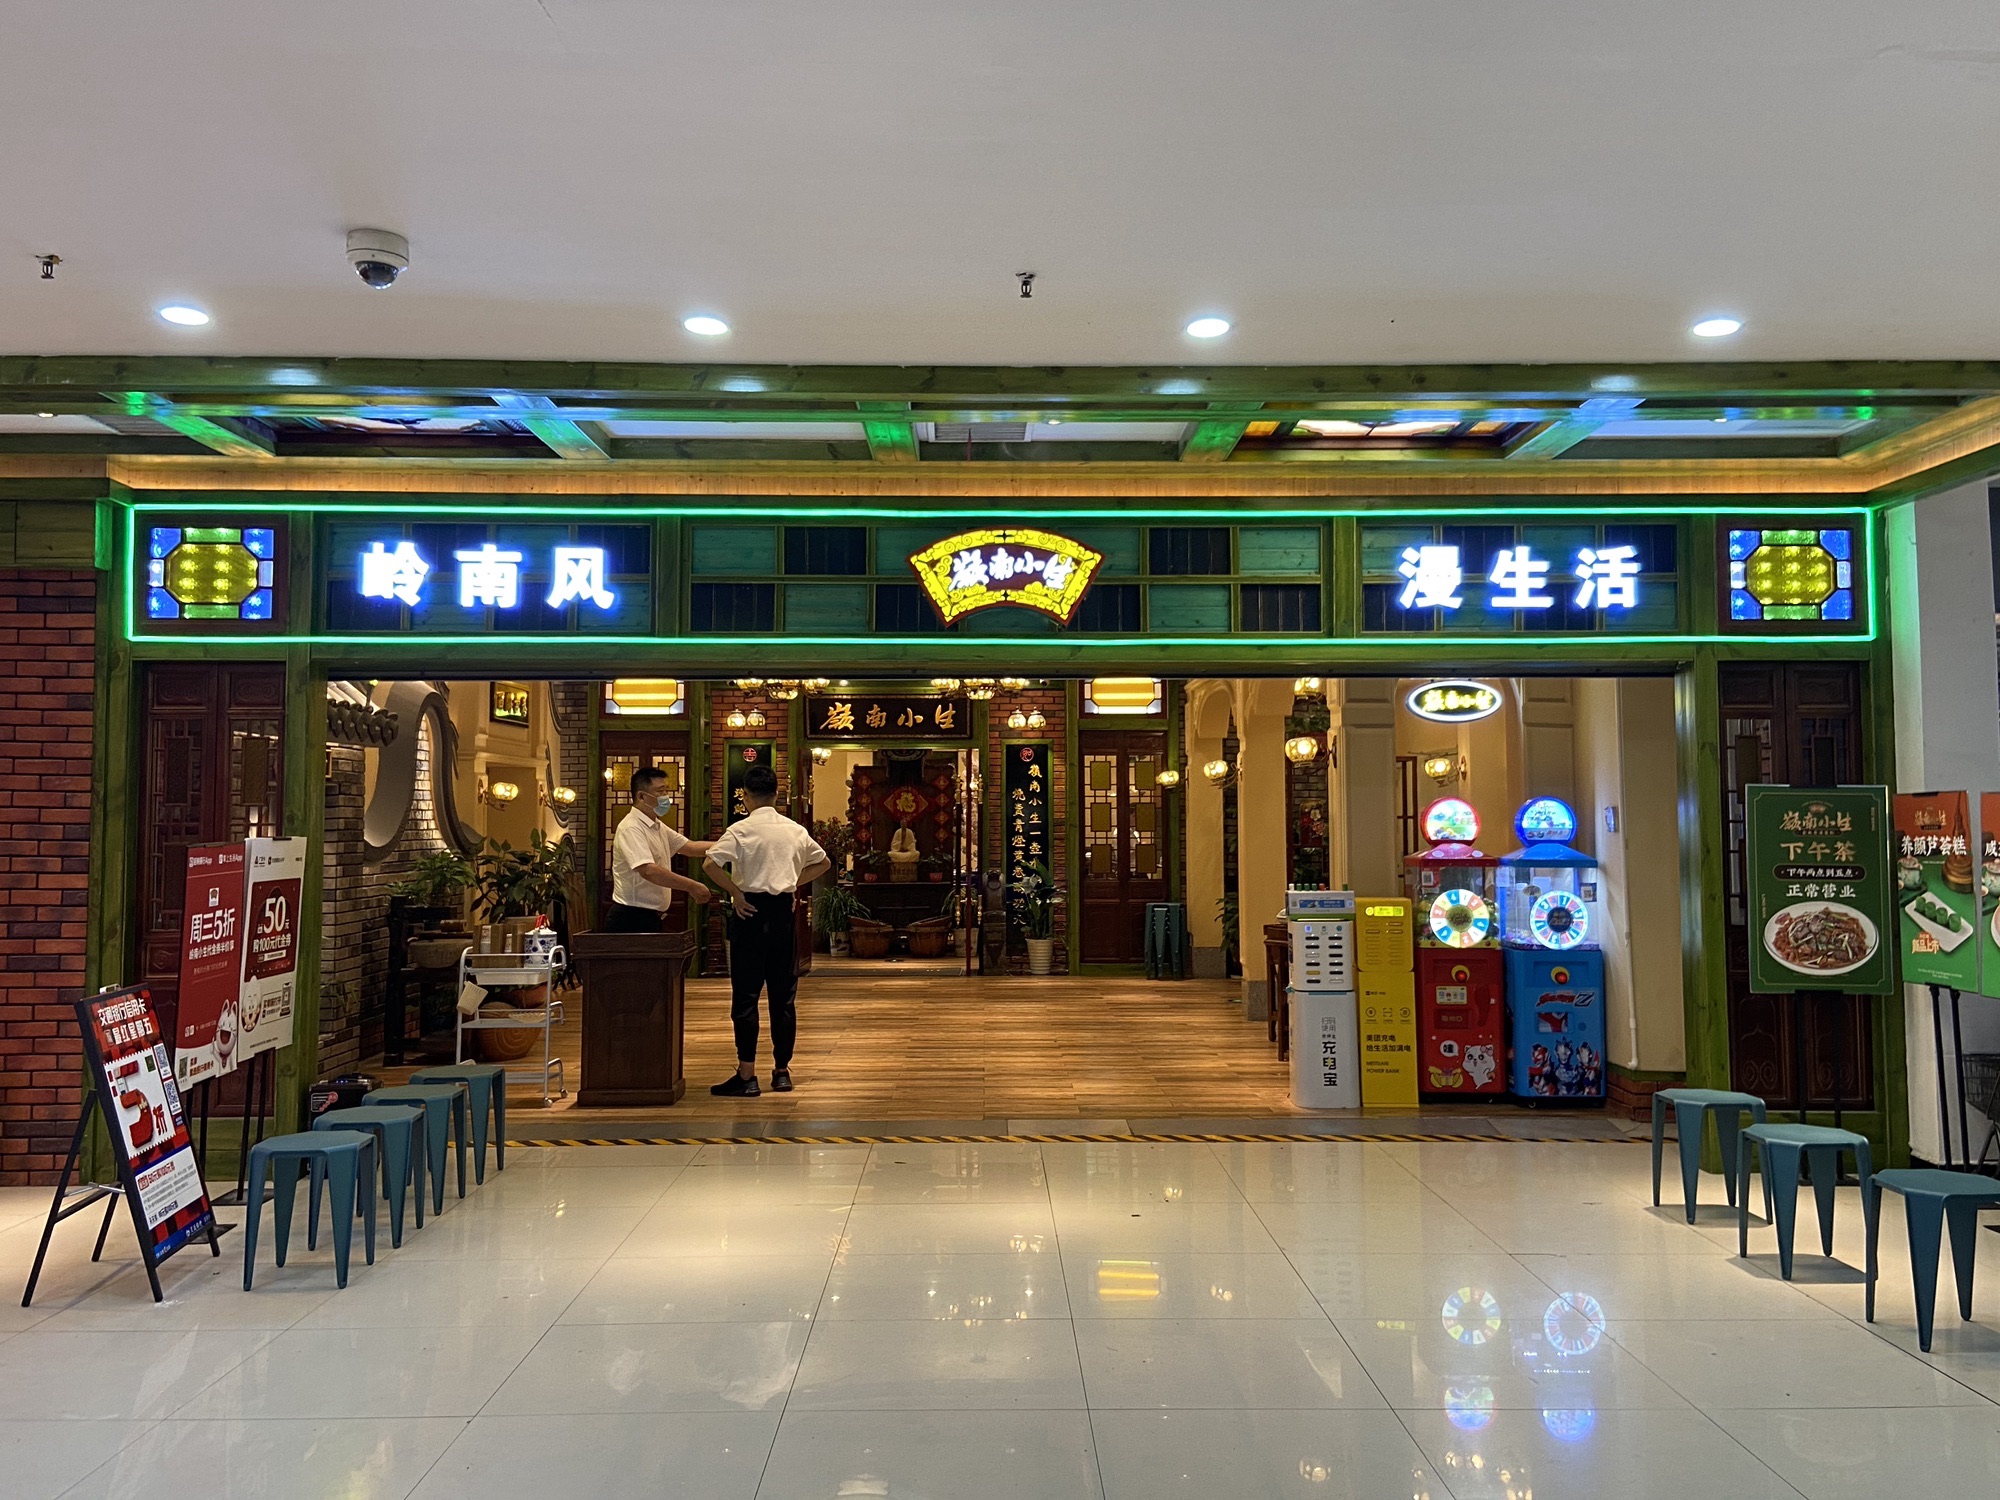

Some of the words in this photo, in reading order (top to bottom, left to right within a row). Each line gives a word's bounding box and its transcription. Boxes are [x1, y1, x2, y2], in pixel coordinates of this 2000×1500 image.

[358, 541, 616, 610] 岭南风
[1398, 545, 1642, 610] 漫生活
[1780, 841, 1856, 862] 下午茶
[1901, 834, 1967, 857] 养颜芦荟糕
[1786, 868, 1854, 878] 下午两点到五点
[1786, 883, 1856, 899] 正常营业
[189, 907, 236, 945] 周三5折
[97, 997, 147, 1027] 交通银行信用卡
[112, 1017, 153, 1045] 最红星期五
[1366, 1034, 1396, 1042] 美团充电
[1366, 1044, 1411, 1052] 给生活加满电
[1321, 1040, 1338, 1087] 充电宝
